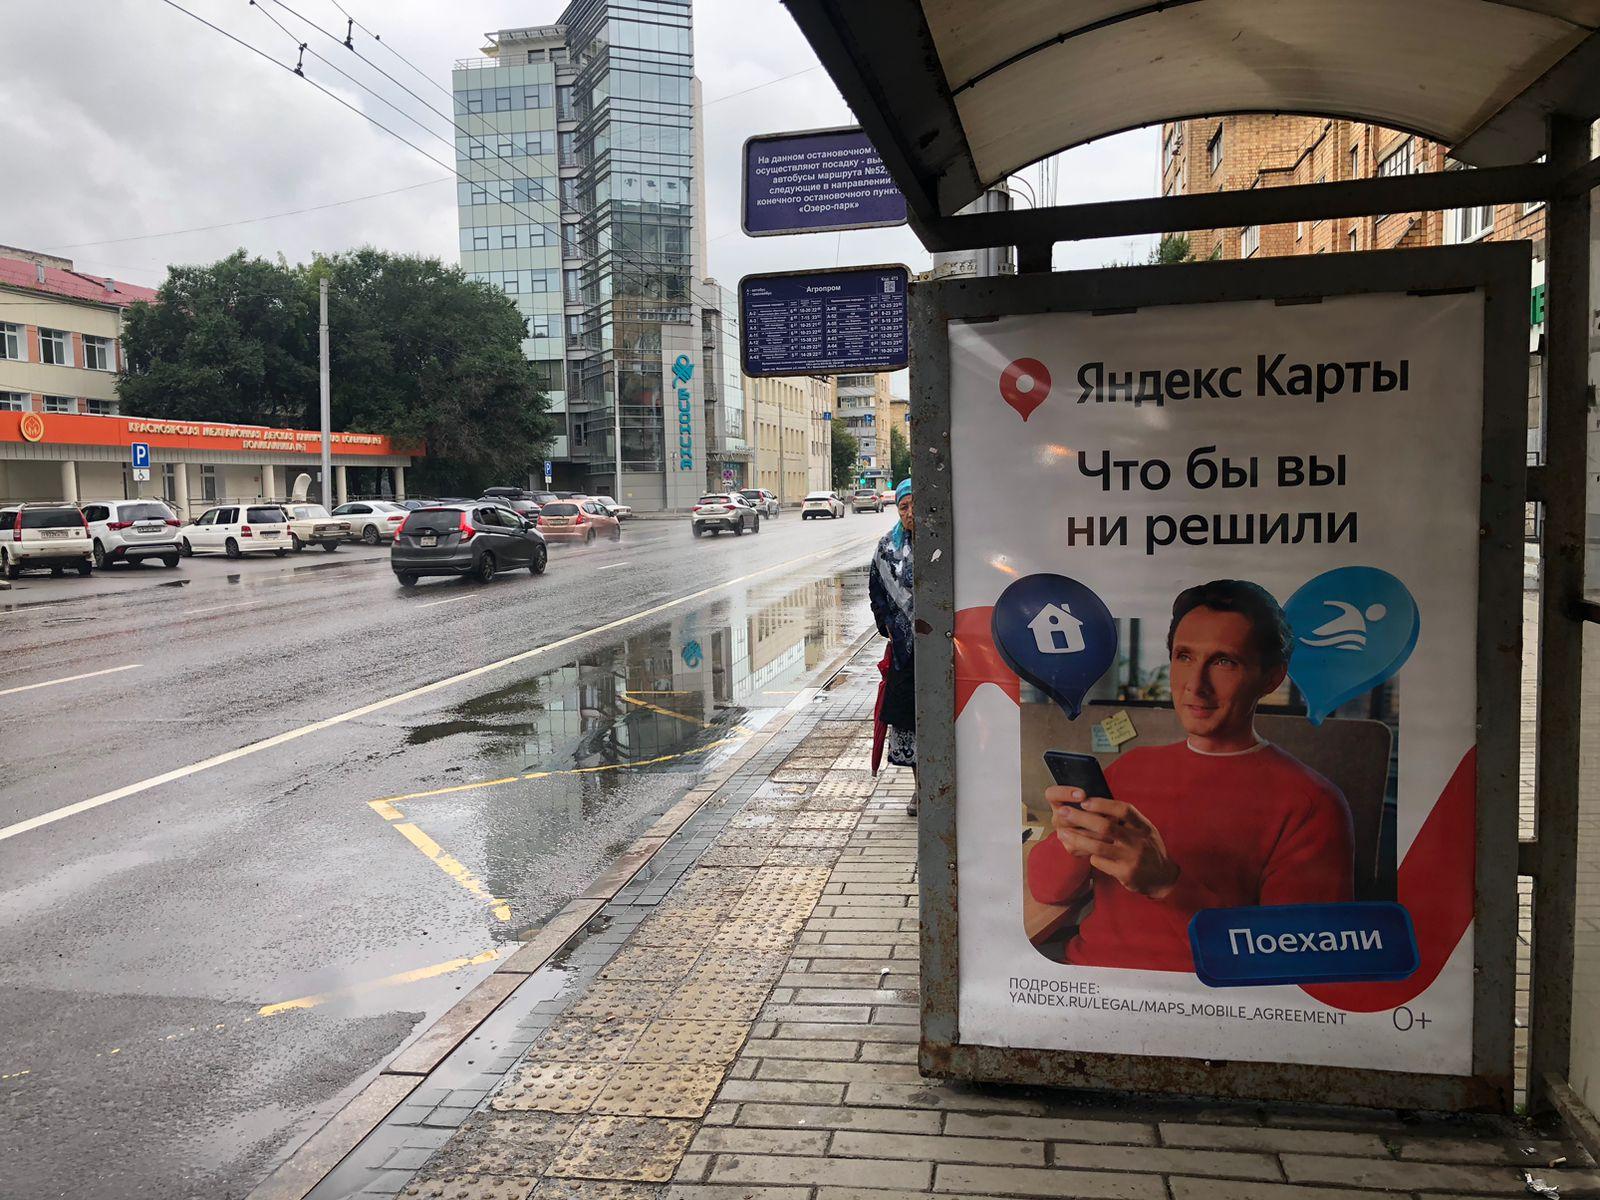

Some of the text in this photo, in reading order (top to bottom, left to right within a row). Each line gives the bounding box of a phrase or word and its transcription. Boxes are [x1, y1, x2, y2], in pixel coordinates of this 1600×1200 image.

[758, 156, 769, 164] На
[771, 154, 805, 164] данном
[806, 148, 872, 160] остановочном
[755, 162, 820, 176] осуществляют
[822, 159, 859, 171] посадку
[773, 166, 888, 184] автобусы маршрута №52,
[769, 184, 821, 195] следующие
[831, 177, 891, 190] направлении
[757, 197, 802, 207] конечного
[804, 190, 871, 202] остановочного
[799, 202, 860, 213] «Озеро-парк»
[806, 285, 841, 294] Агропром
[1077, 353, 1409, 407] Яндекс Карты
[128, 422, 199, 436] КРАСНОЯРСКАЯ
[1077, 445, 1346, 491] Что бы вы
[1067, 511, 1357, 555] ни решили
[1228, 928, 1383, 955] Поехали
[1009, 977, 1101, 995] ПОДРОБНЕЕ:
[1009, 992, 1347, 1025] YANDEX.RU/LEGAL/MAPS_MOBILE_AGREEMENT
